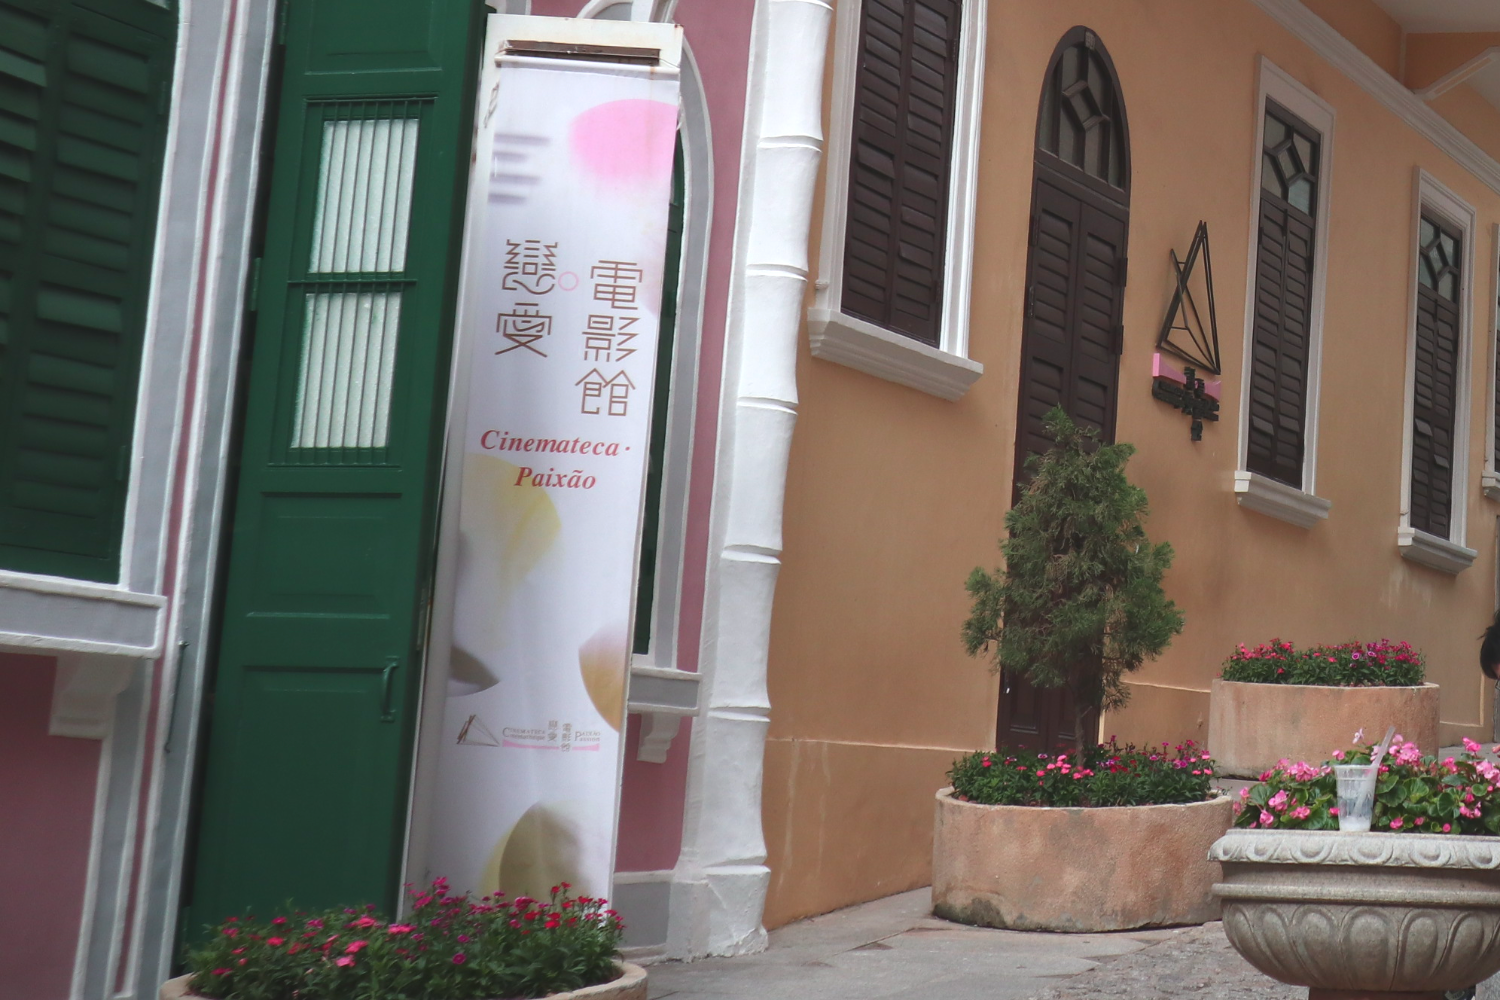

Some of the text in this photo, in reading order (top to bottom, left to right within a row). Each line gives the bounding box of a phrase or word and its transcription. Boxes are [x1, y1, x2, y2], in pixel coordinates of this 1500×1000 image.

[495, 239, 558, 357] 戀愛
[575, 260, 643, 417] 電影館
[514, 466, 596, 490] Paixão
